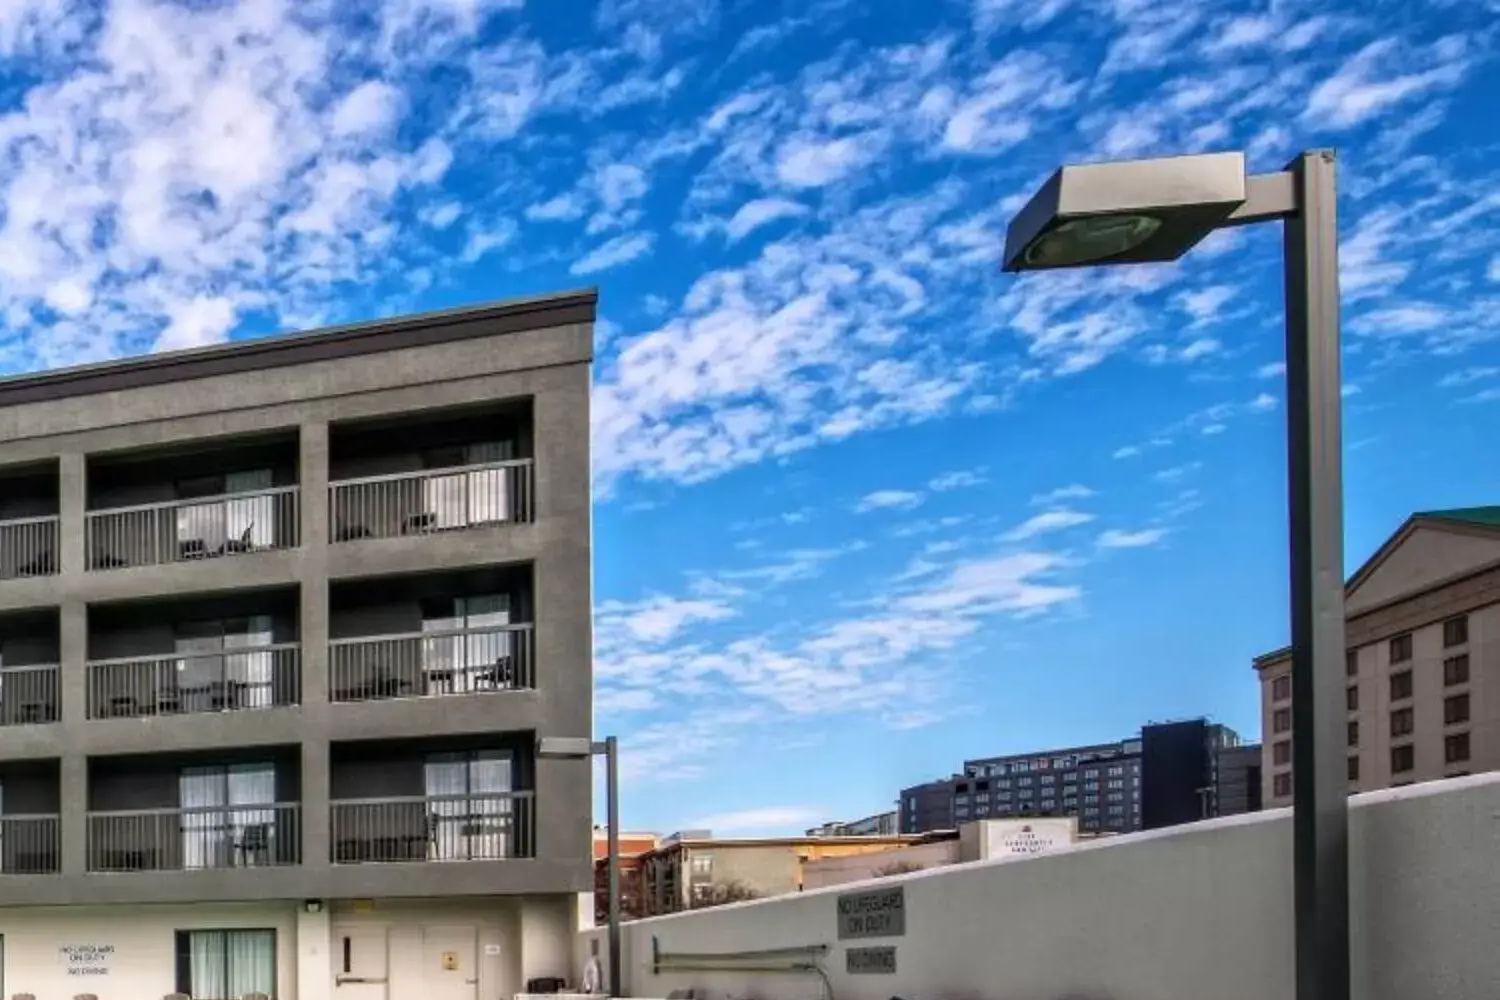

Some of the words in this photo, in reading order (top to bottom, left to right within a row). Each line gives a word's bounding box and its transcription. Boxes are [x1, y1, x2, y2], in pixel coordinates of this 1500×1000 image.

[838, 898, 851, 914] NO
[852, 893, 902, 914] LIFEGUARD
[848, 917, 863, 933] ON
[865, 912, 891, 933] DUTY
